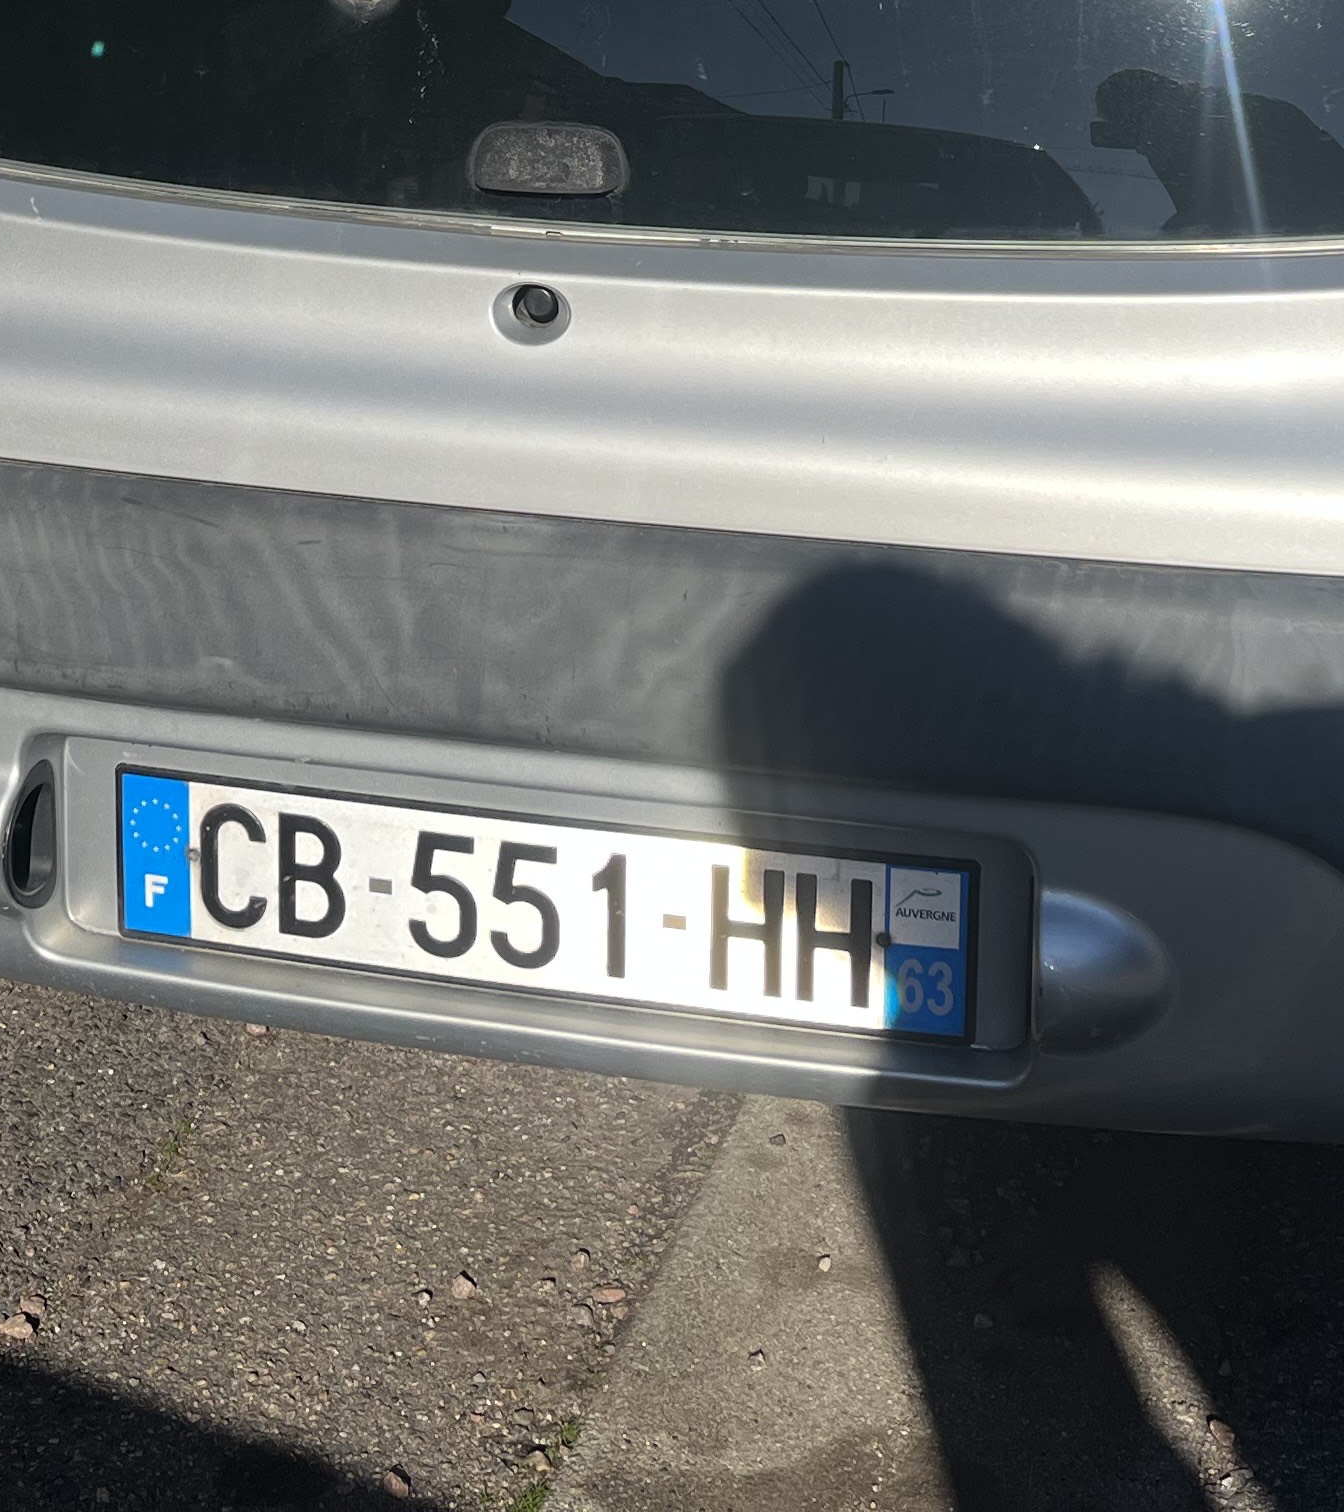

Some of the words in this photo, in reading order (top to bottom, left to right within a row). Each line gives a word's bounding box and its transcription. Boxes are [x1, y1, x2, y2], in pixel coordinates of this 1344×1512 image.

[144, 873, 169, 908] F
[895, 907, 957, 923] AUVERGNE
[897, 958, 955, 1017] 63
